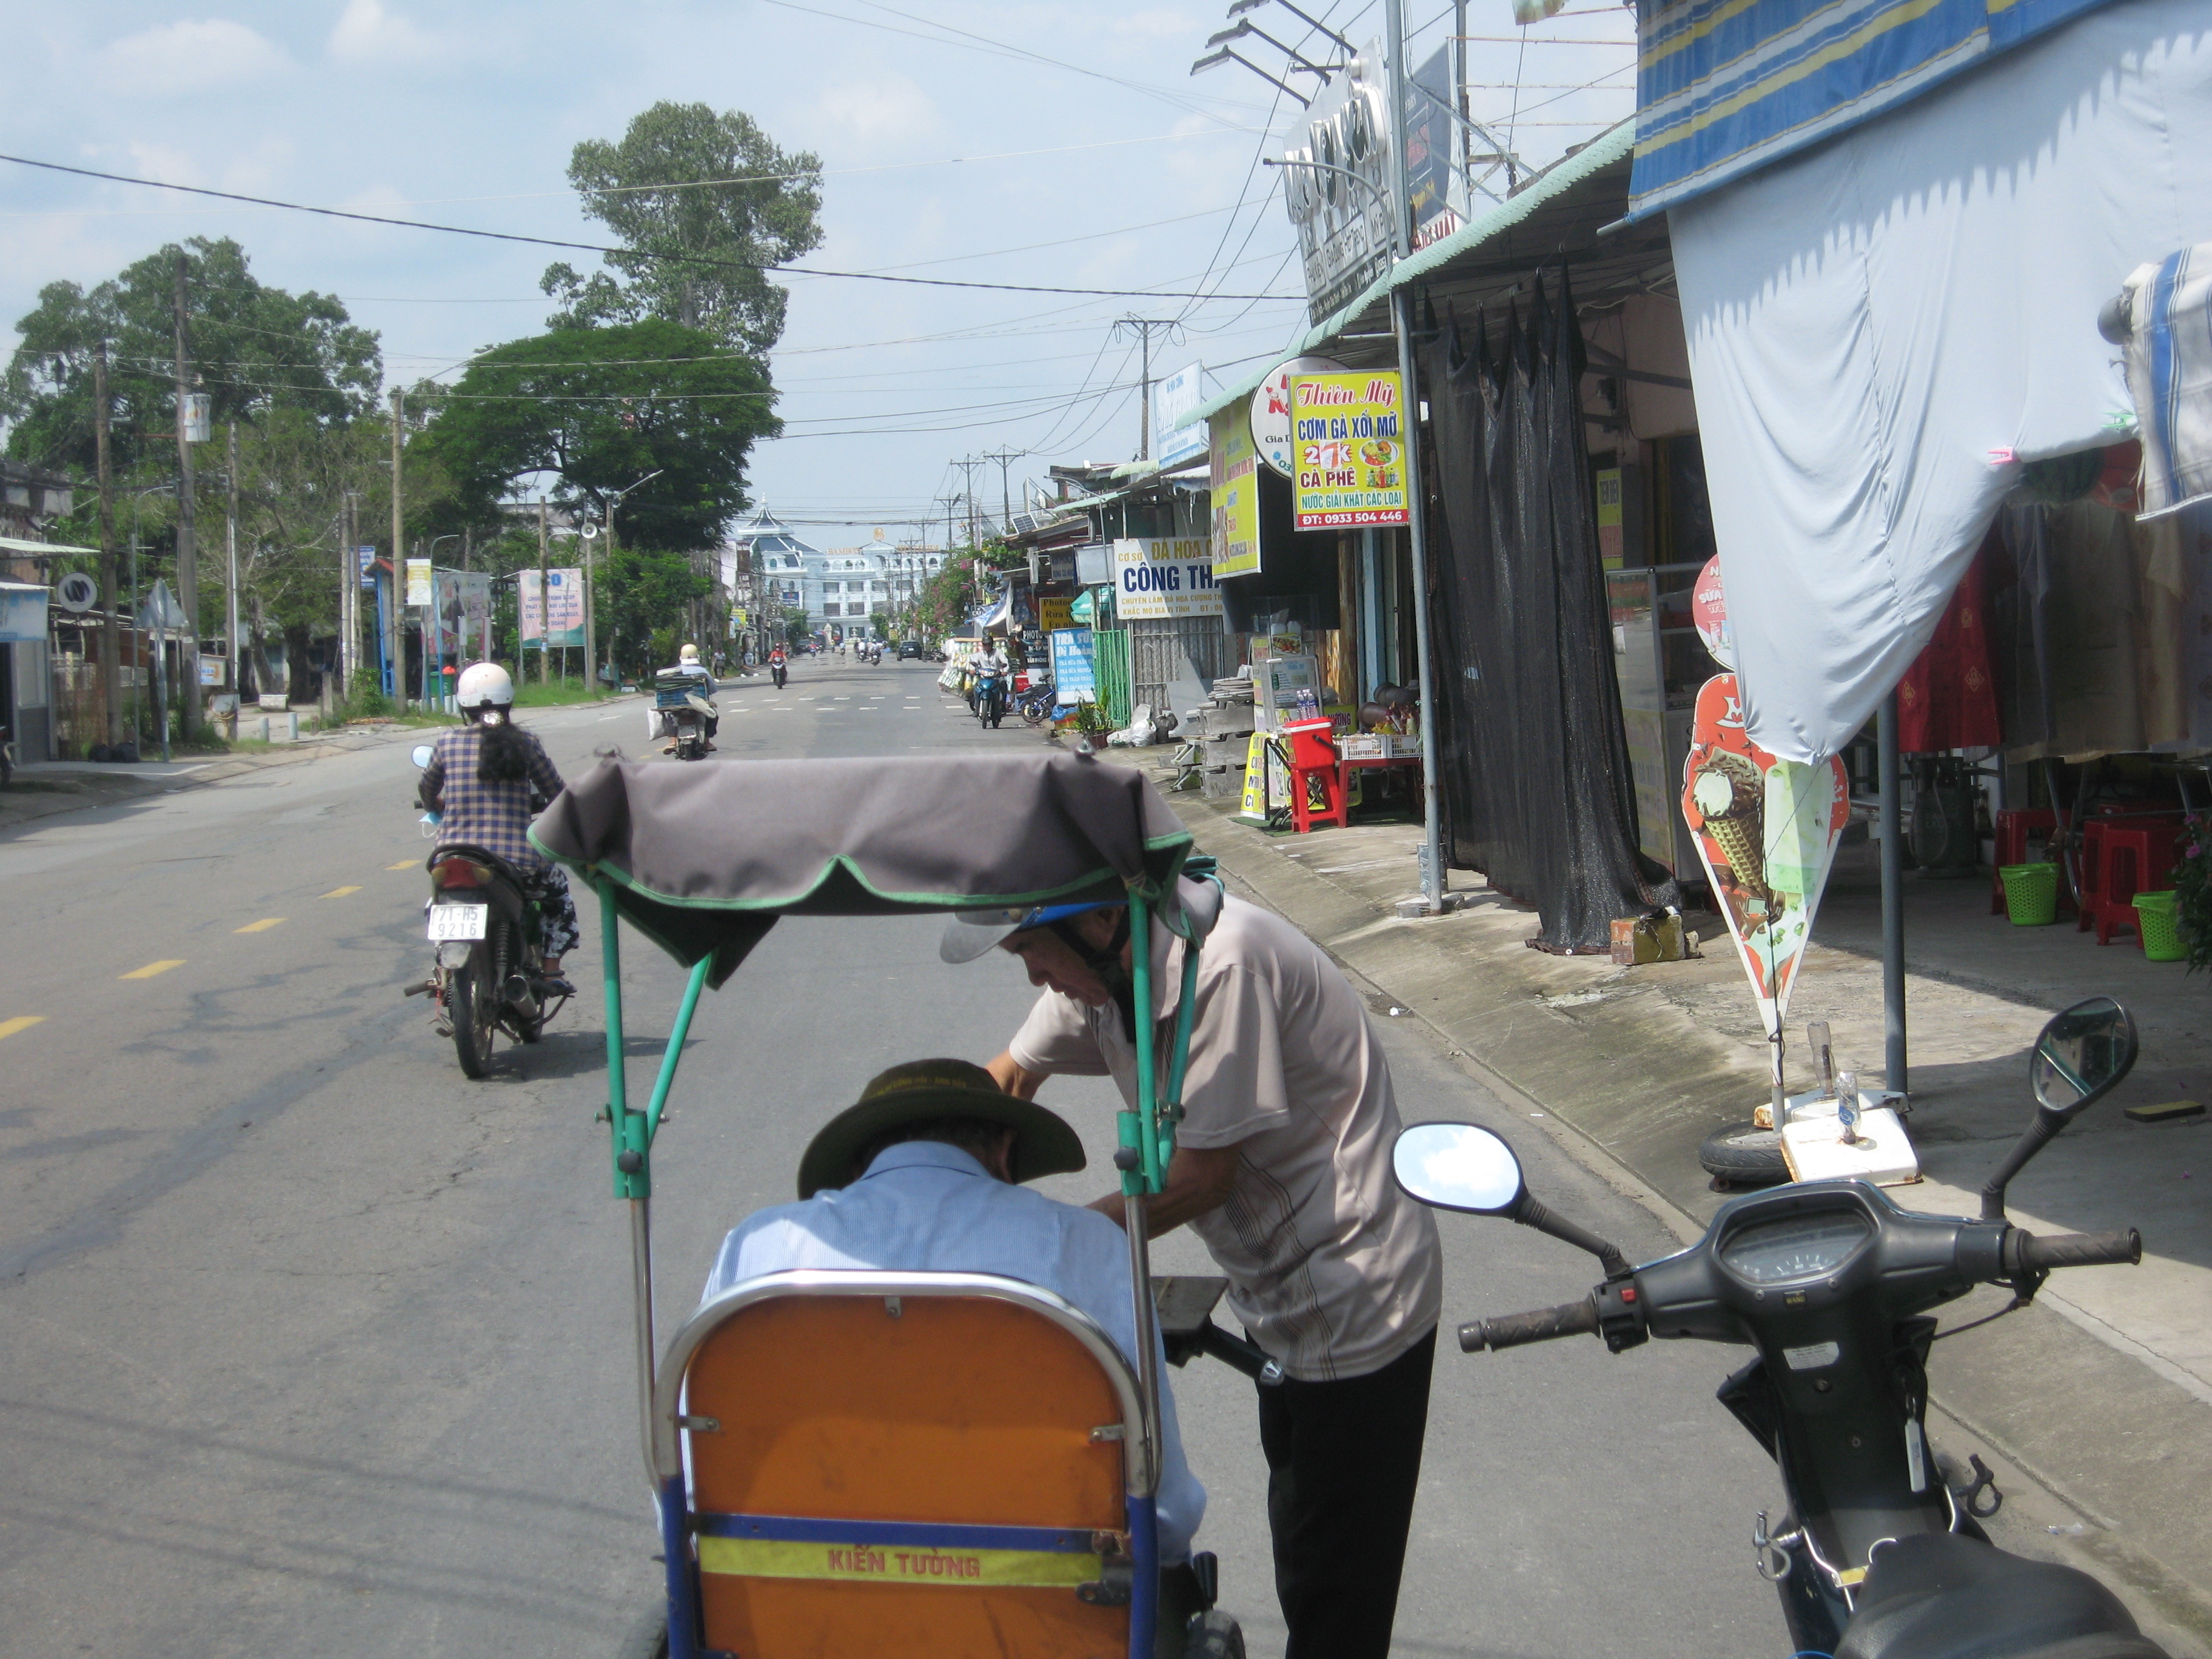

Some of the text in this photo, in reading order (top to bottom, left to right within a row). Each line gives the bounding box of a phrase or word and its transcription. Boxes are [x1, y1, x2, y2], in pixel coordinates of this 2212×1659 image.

[1296, 380, 1396, 407] Thiên Mỹ
[1298, 409, 1397, 440] CƠM GÀ XỐI MỠ
[1265, 435, 1283, 443] Gia
[1304, 442, 1352, 468] 27K
[1301, 468, 1355, 488] CÀ PHÊ
[1302, 490, 1401, 509] NƯỚC GIẢI KHÁT CÁC LOẠI
[1302, 511, 1402, 525] ĐT: 0933 504 446
[1118, 552, 1129, 561] CƠ
[1131, 552, 1142, 561] SỞ
[1151, 538, 1170, 560] ĐÁ
[1174, 540, 1201, 559] HOA
[1124, 561, 1179, 592] CÔNG
[1698, 588, 1722, 604] SỮA
[438, 923, 477, 937] 9216
[828, 1544, 885, 1573] KIẾN
